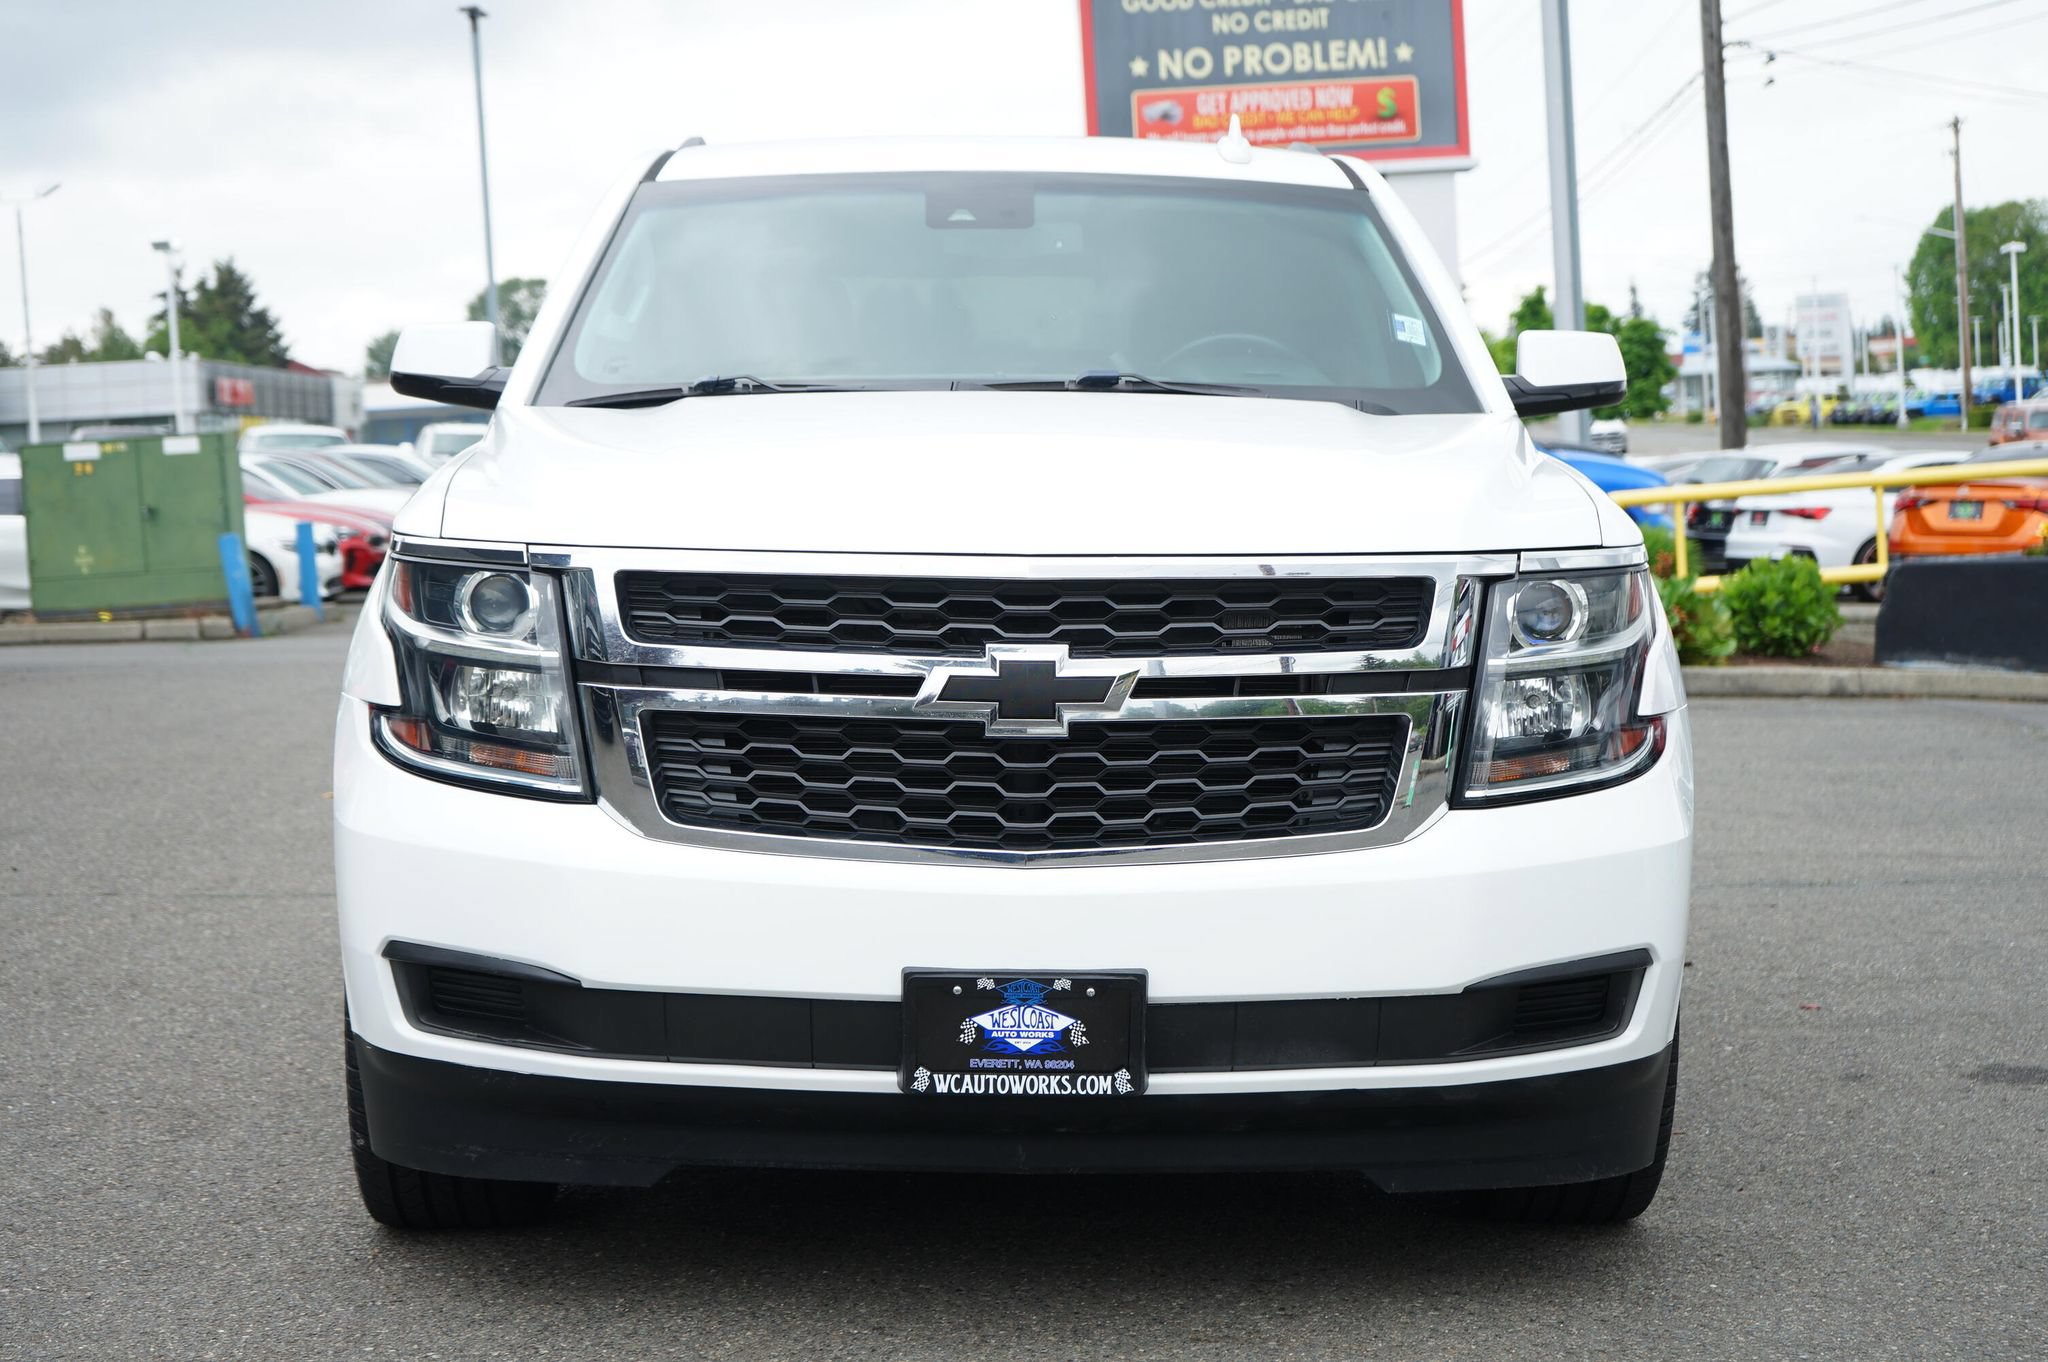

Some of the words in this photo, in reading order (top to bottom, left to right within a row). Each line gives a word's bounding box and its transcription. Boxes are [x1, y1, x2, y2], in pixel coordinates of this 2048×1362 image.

[1211, 11, 1249, 34] NO
[1254, 7, 1330, 33] CREDIT
[1158, 47, 1213, 80] NO
[1223, 37, 1388, 76] PROBLEM!
[1196, 92, 1226, 115] GET
[1230, 86, 1313, 113] APPROVED
[1315, 85, 1354, 108] NOW
[1020, 1031, 1055, 1039] WORKS
[969, 1058, 1023, 1070] EVERETT,
[1024, 1059, 1043, 1069] WA
[933, 1074, 1112, 1095] WCAUTOWORKS.COM
